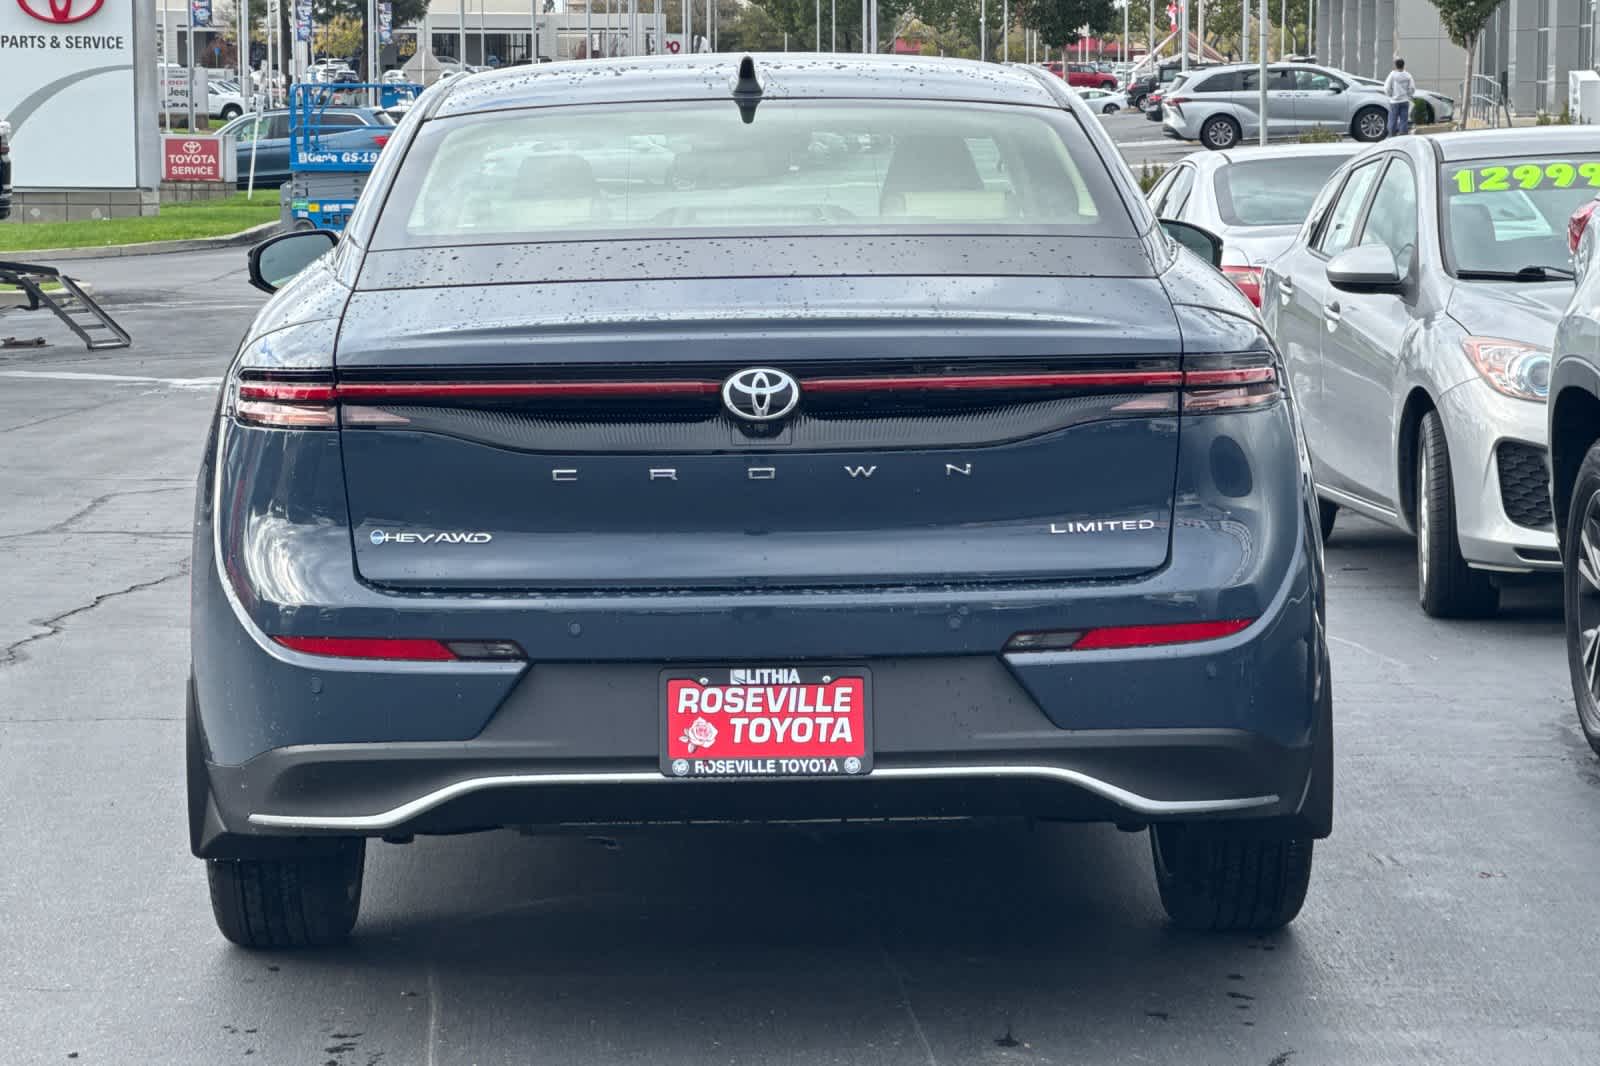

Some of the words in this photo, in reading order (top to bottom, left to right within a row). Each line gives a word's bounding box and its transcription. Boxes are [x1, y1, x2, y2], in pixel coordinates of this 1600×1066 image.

[1, 35, 46, 49] PARTS
[50, 35, 61, 49] &
[65, 35, 125, 49] SERVICE
[168, 154, 217, 165] TOYOTA
[341, 151, 381, 163] GS-19
[171, 166, 215, 176] SERVICE
[1452, 161, 1600, 193] 12999
[551, 463, 972, 481] CROWN
[1050, 519, 1155, 534] LIMITED
[745, 669, 800, 685] LITHIA
[677, 687, 853, 713] ROSEVILLE
[729, 717, 853, 743] TOYOTA
[695, 759, 777, 774] ROSEVILLE
[779, 759, 838, 773] TOYOTA
